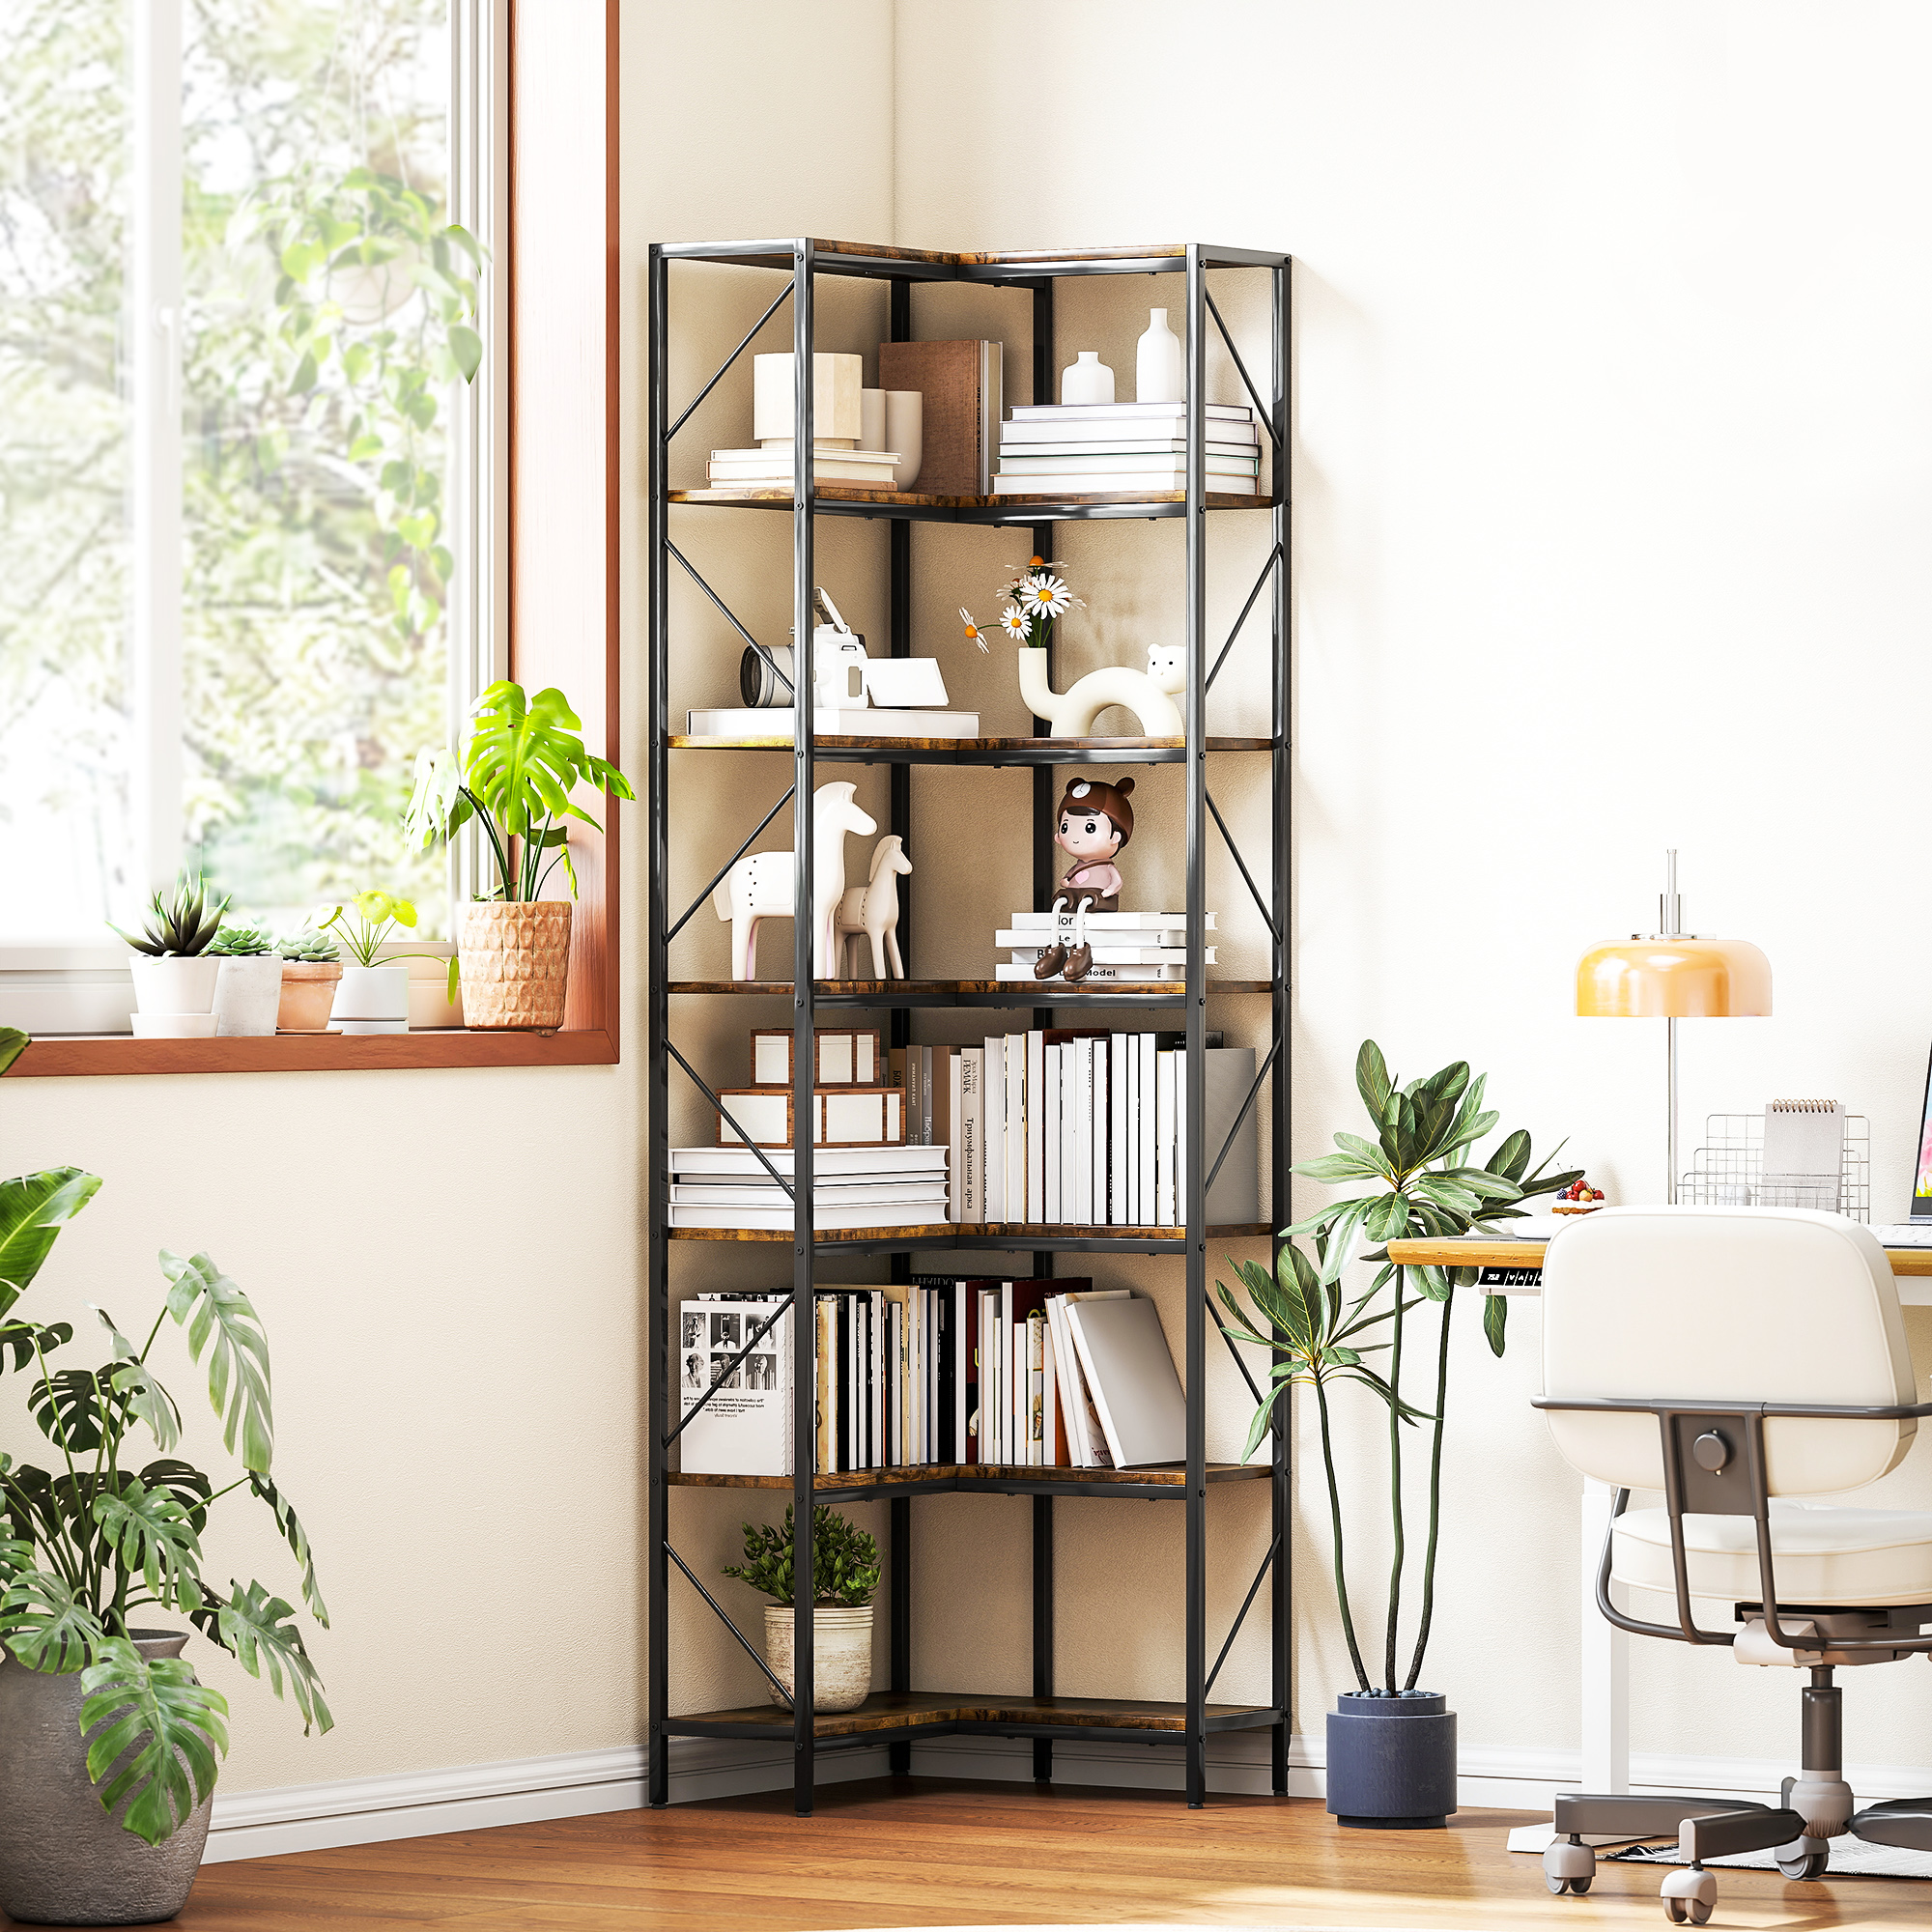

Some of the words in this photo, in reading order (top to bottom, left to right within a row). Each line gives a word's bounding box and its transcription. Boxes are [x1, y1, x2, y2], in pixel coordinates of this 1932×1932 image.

[1058, 915, 1074, 925] lor
[964, 1117, 975, 1185] Триумфальная
[964, 1188, 974, 1209] арка
